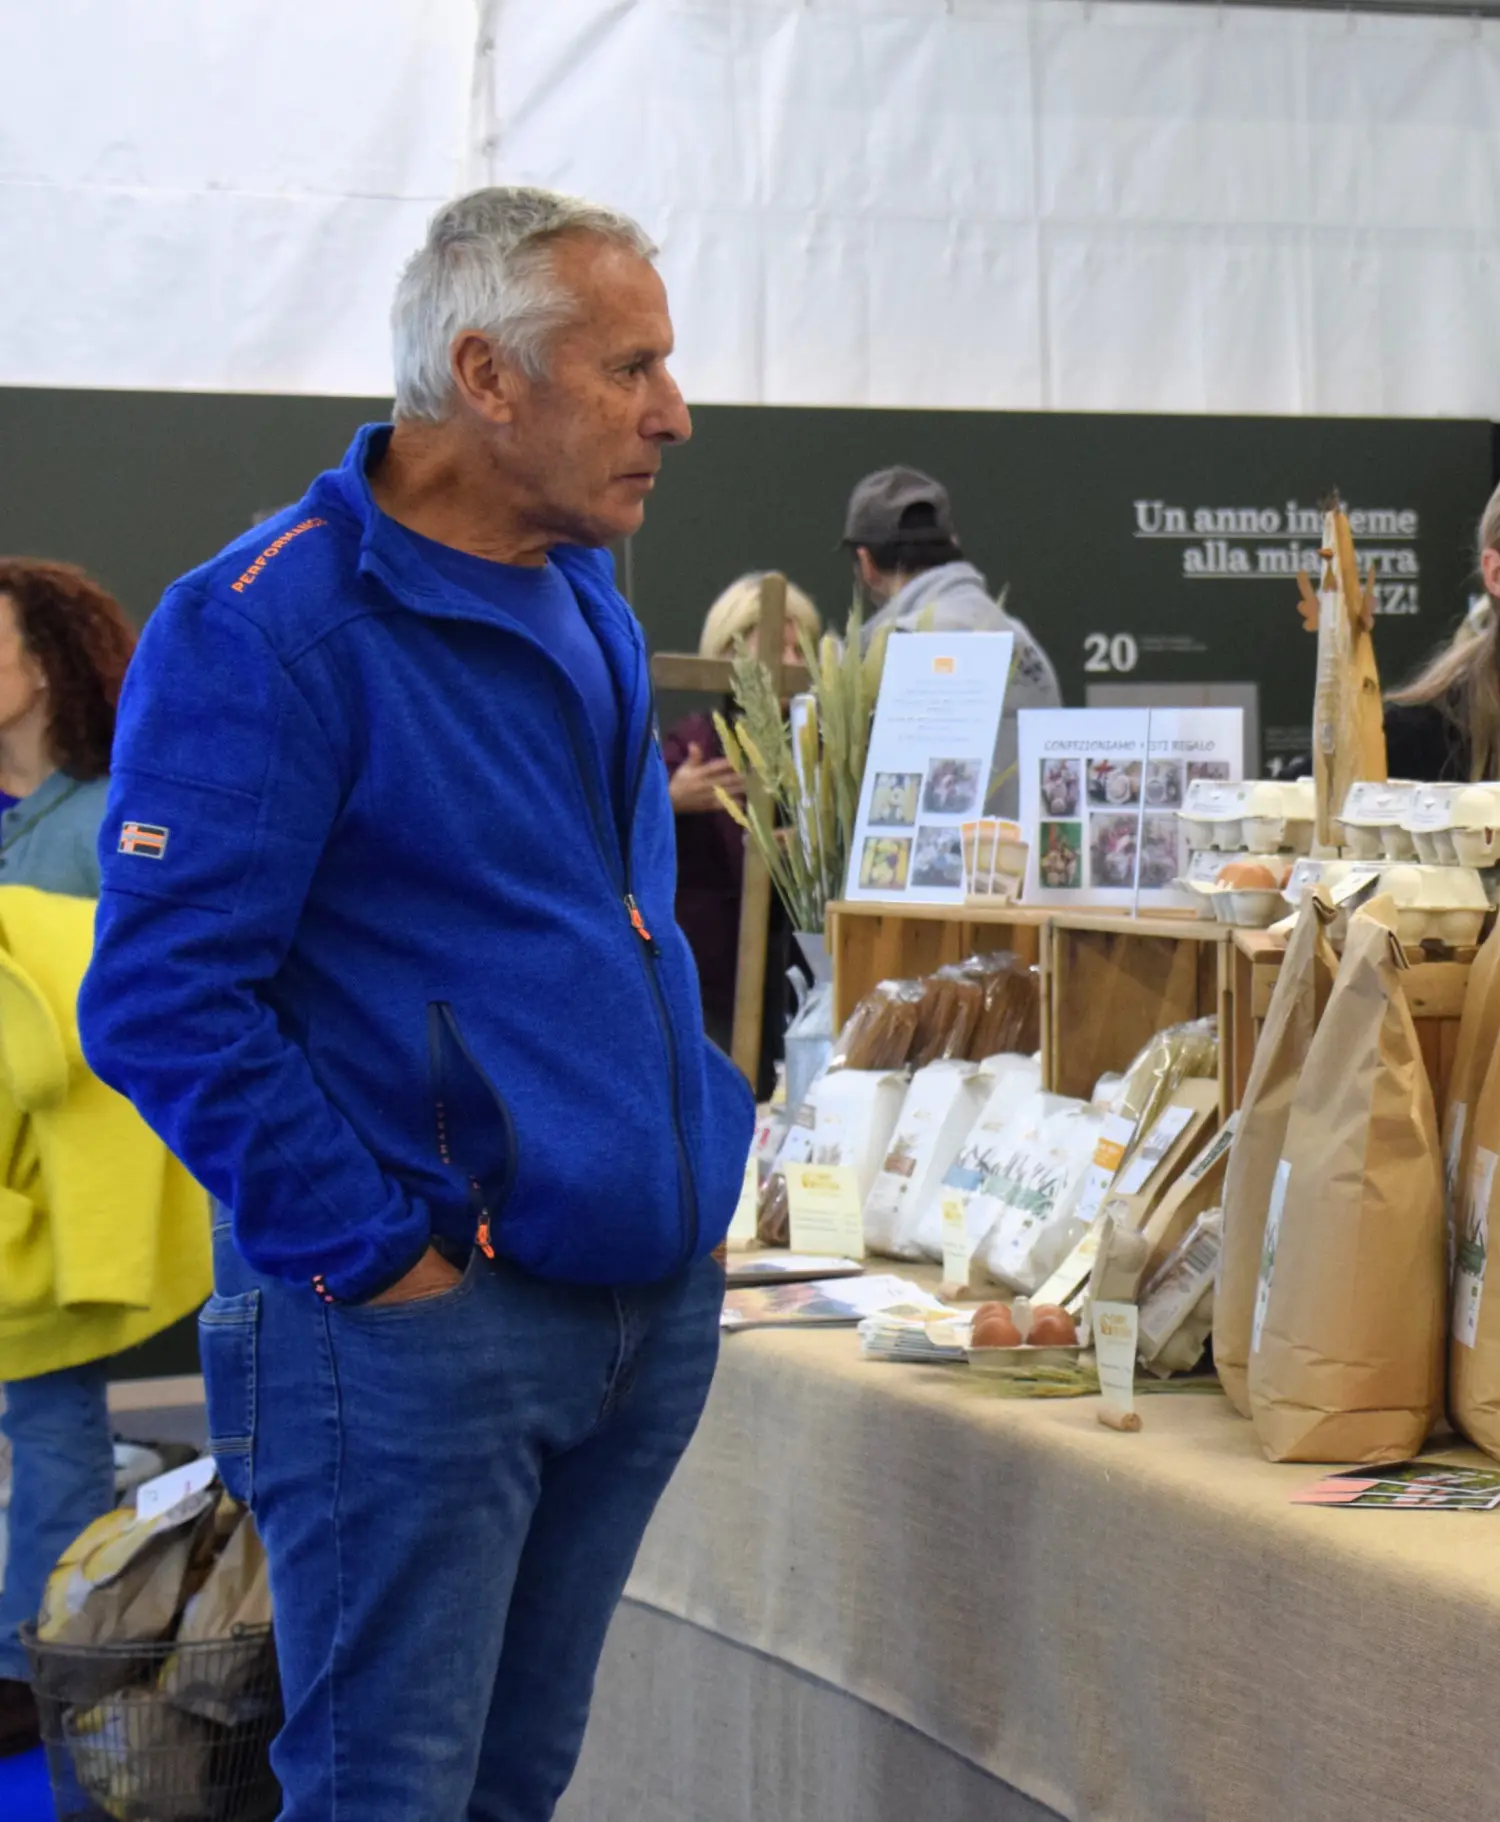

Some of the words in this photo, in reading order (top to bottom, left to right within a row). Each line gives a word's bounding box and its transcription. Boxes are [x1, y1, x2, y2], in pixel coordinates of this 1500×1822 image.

[1133, 500, 1187, 533] Un
[1195, 508, 1281, 533] anno
[1286, 500, 1418, 534] ineme
[1184, 541, 1250, 573] alla
[1258, 541, 1321, 573] mia
[1353, 548, 1419, 574] erra
[1084, 633, 1138, 672] 20
[1171, 739, 1216, 751] REGALO
